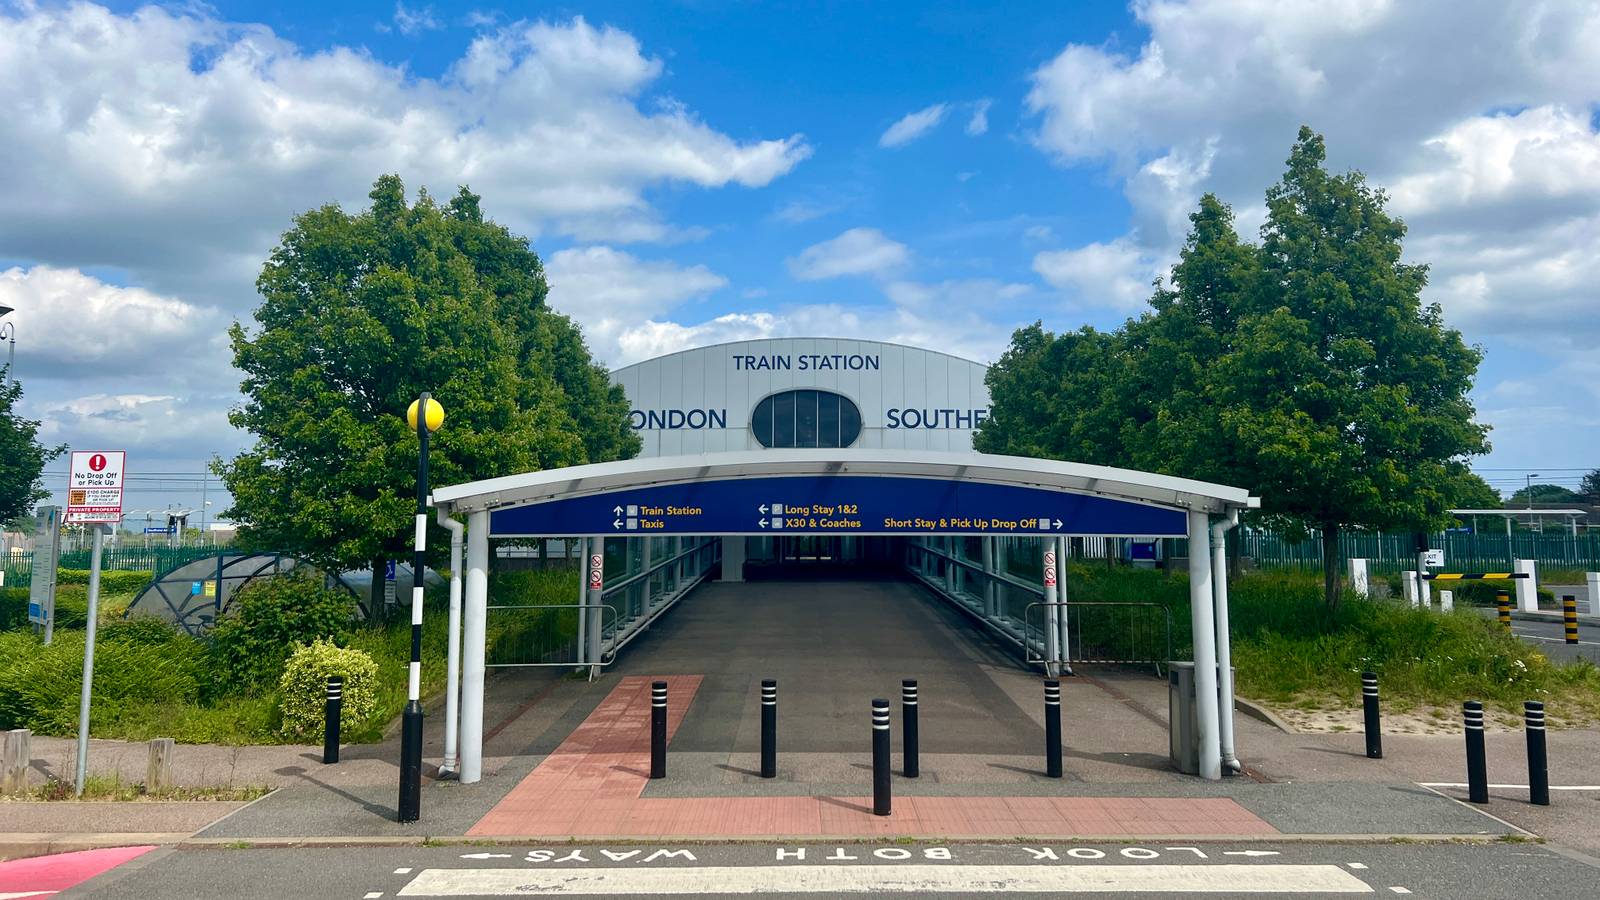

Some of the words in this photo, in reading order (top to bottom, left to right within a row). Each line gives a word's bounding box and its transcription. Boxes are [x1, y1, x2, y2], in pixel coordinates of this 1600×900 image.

[733, 355, 791, 370] TRAIN
[798, 354, 880, 370] STATION
[628, 408, 727, 430] ONDON
[886, 408, 988, 429] SOUTHE
[640, 506, 664, 515] Train
[667, 506, 702, 515] Station
[785, 505, 809, 515] Long
[812, 505, 834, 515] Stay
[837, 504, 858, 514] 1&2
[640, 519, 664, 529] Taxis
[785, 518, 806, 528] X30
[808, 518, 817, 528] &
[820, 518, 862, 528] Coaches
[884, 518, 912, 528] Short
[914, 518, 936, 530] Stay
[939, 518, 948, 528] &
[950, 518, 971, 528] Pick
[974, 518, 989, 530] Up
[991, 518, 1017, 530] Drop
[1020, 518, 1037, 528] Off
[523, 848, 698, 863] WAYS
[775, 846, 952, 861] BOTH
[1022, 846, 1209, 861] LOOK
